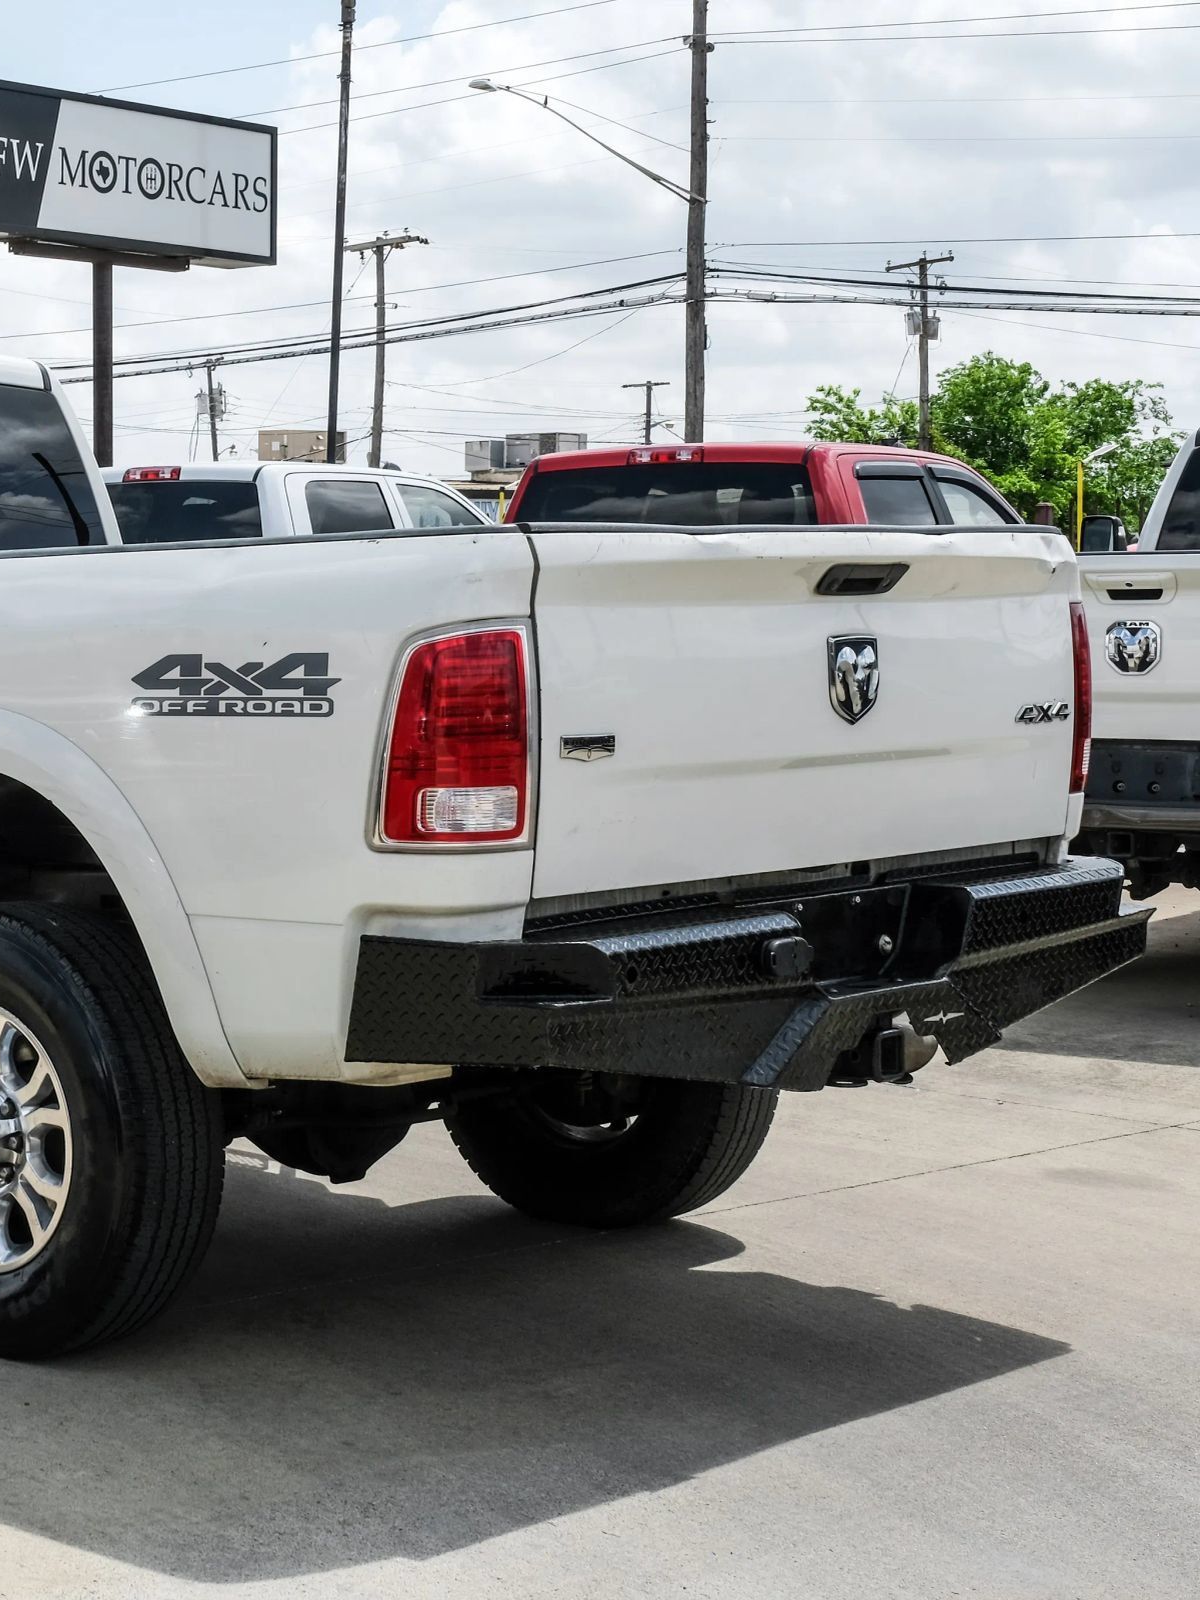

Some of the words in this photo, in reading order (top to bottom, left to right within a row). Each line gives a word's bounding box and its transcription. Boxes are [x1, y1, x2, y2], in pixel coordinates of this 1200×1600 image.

[58, 146, 268, 213] MOTORCARS
[135, 699, 211, 714] OFF
[218, 699, 330, 714] ROAD
